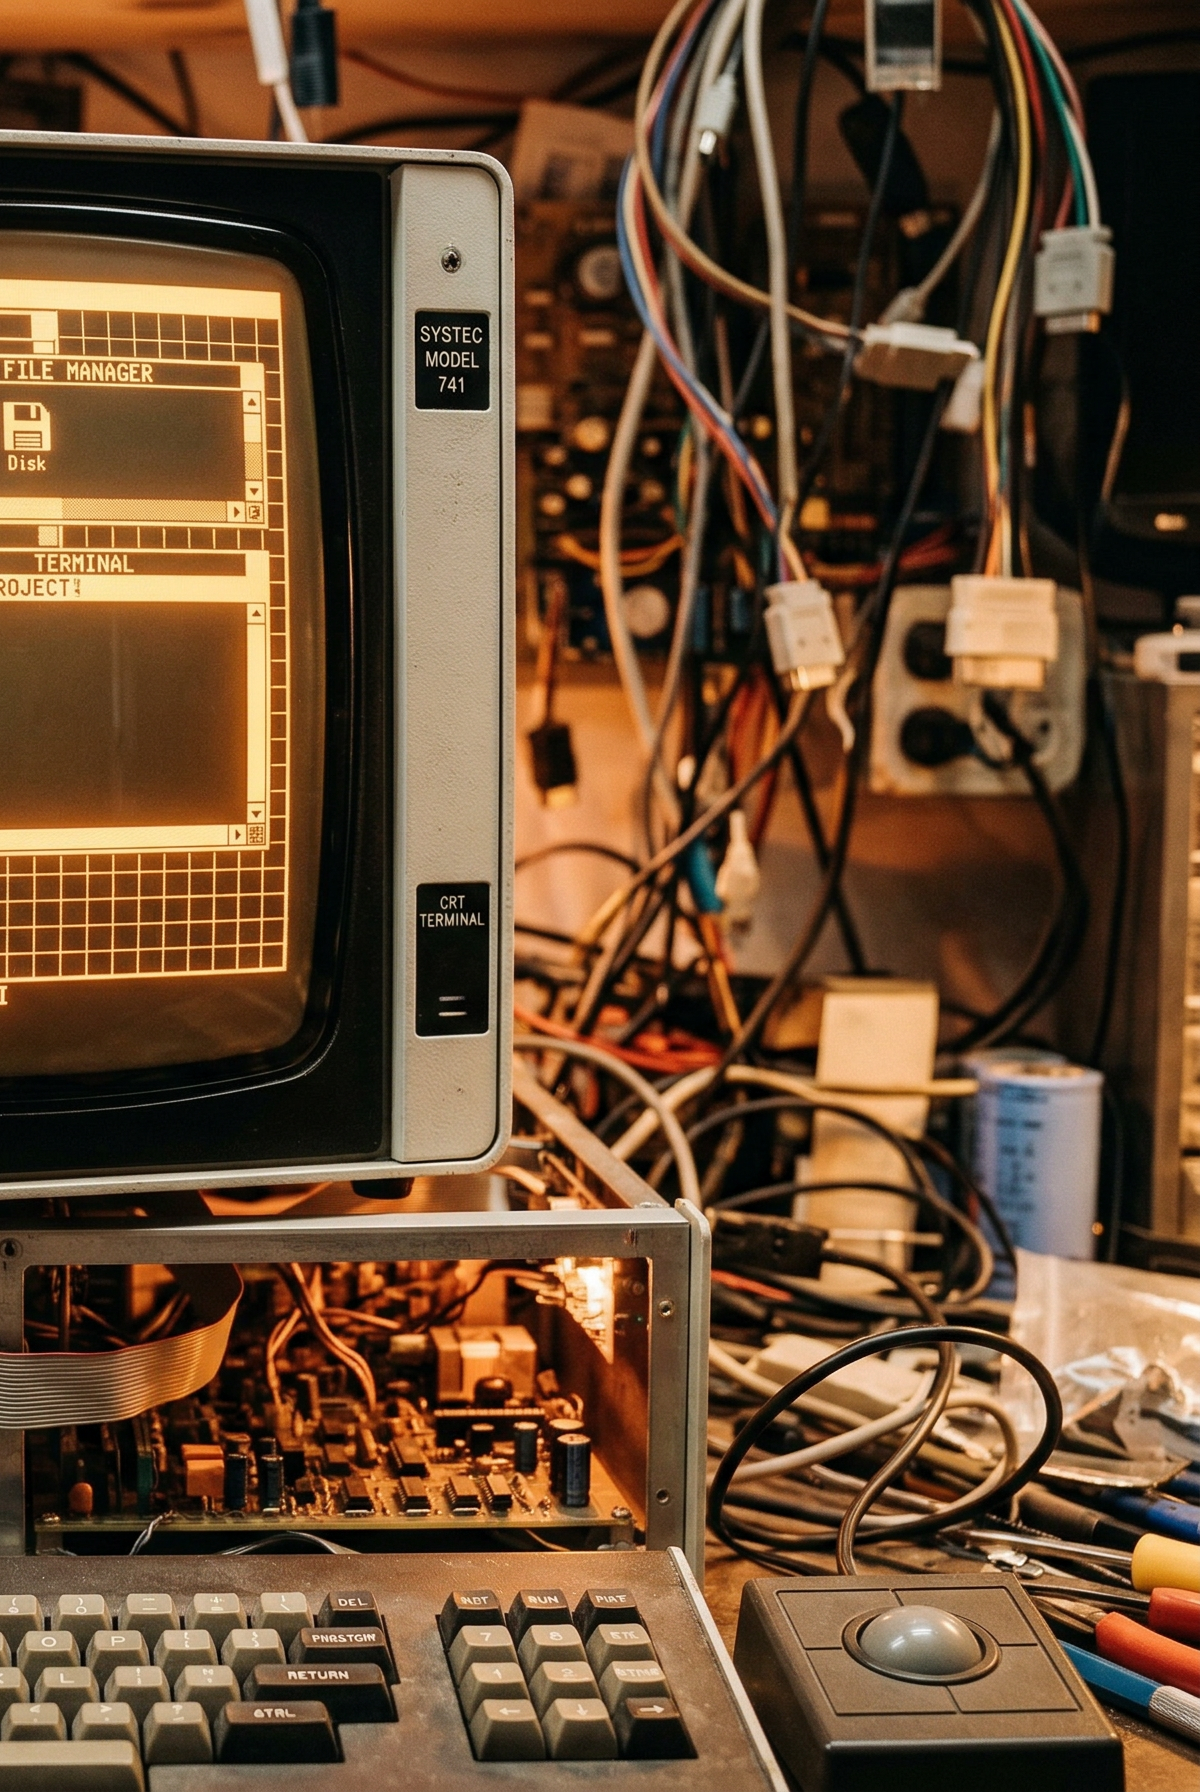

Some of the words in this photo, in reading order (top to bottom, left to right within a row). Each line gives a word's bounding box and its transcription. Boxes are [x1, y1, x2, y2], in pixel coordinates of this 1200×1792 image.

[420, 325, 483, 344] SYSTEC
[425, 350, 480, 369] MODEL
[3, 359, 55, 381] FILE
[66, 361, 154, 384] MANAGER
[438, 375, 464, 393] 741
[7, 454, 46, 472] Disk
[34, 553, 135, 573] TERMINAL
[439, 894, 466, 910] CRT
[419, 912, 485, 928] TERMINAL
[338, 1597, 367, 1607] DEL
[41, 1636, 57, 1648] O
[110, 1635, 126, 1647] P
[480, 1632, 492, 1642] 7
[59, 1672, 74, 1684] L
[287, 1670, 349, 1680] RETURN
[493, 1668, 502, 1679] 1
